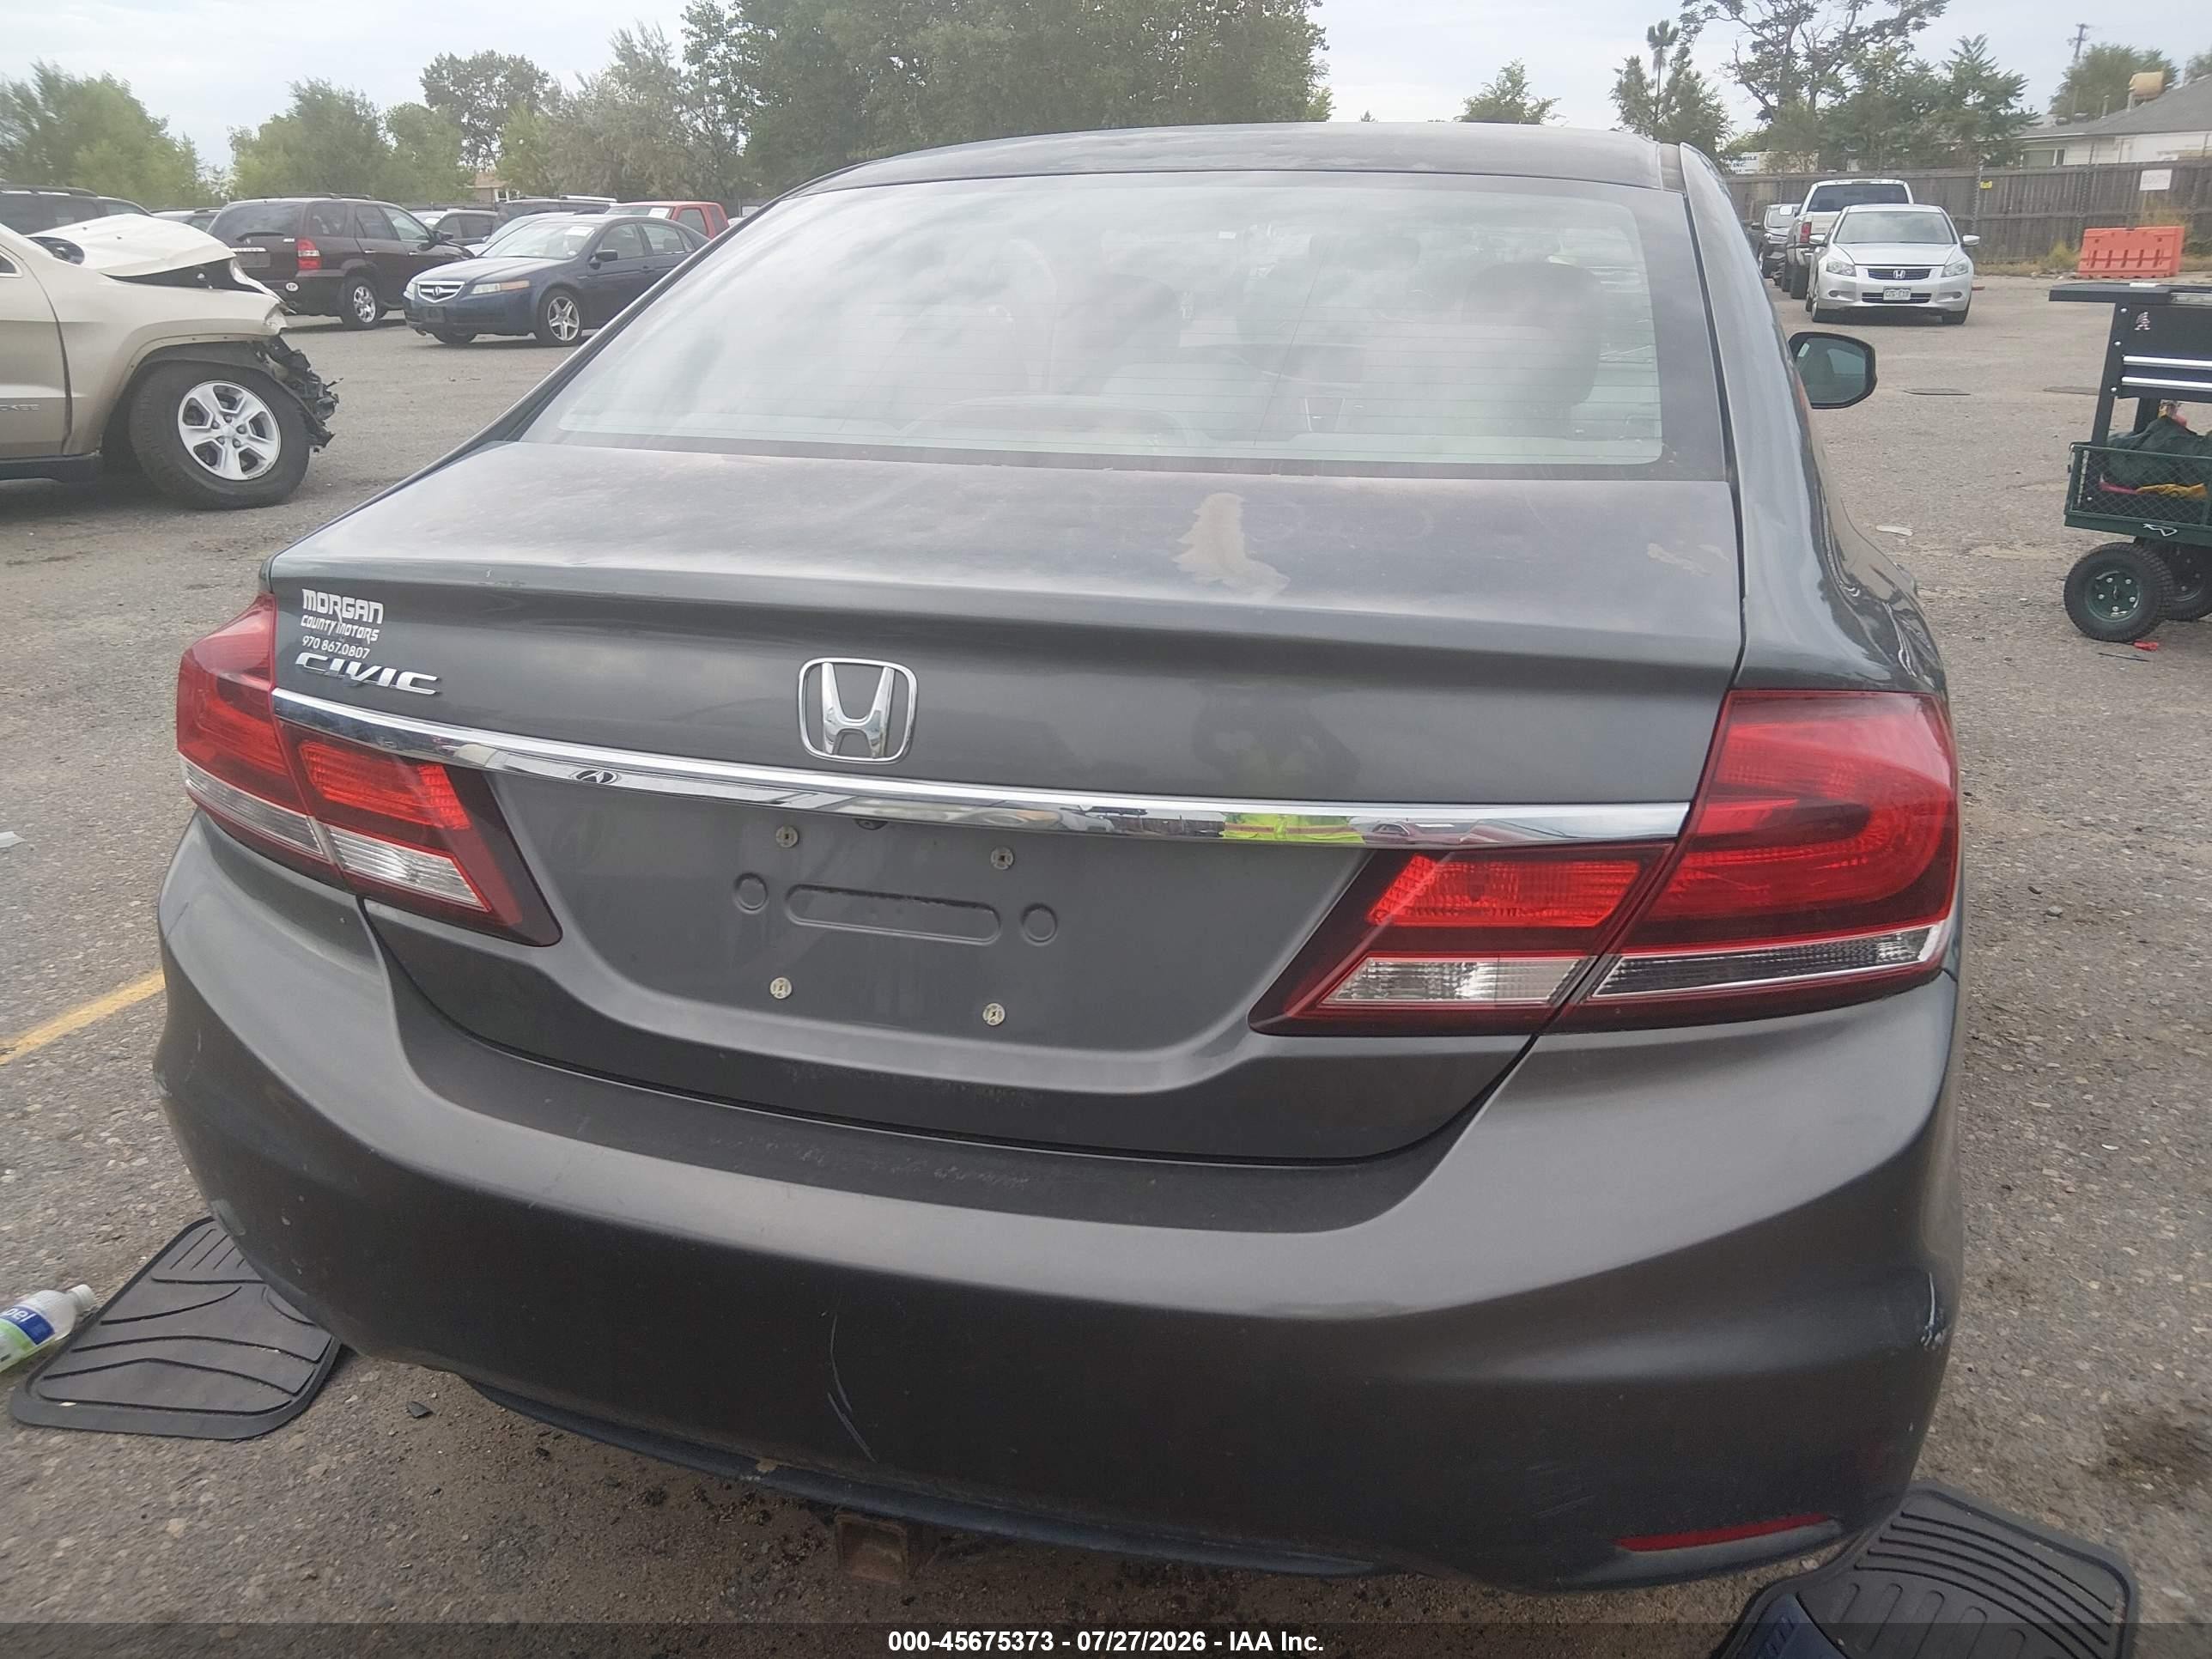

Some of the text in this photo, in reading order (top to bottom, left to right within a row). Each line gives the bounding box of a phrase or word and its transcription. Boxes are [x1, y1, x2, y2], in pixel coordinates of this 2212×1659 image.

[302, 588, 384, 624] MORGAN
[301, 615, 380, 645] COUNTY MOTORS
[301, 635, 370, 659] 970 867.0807
[295, 652, 440, 696] CIVIC
